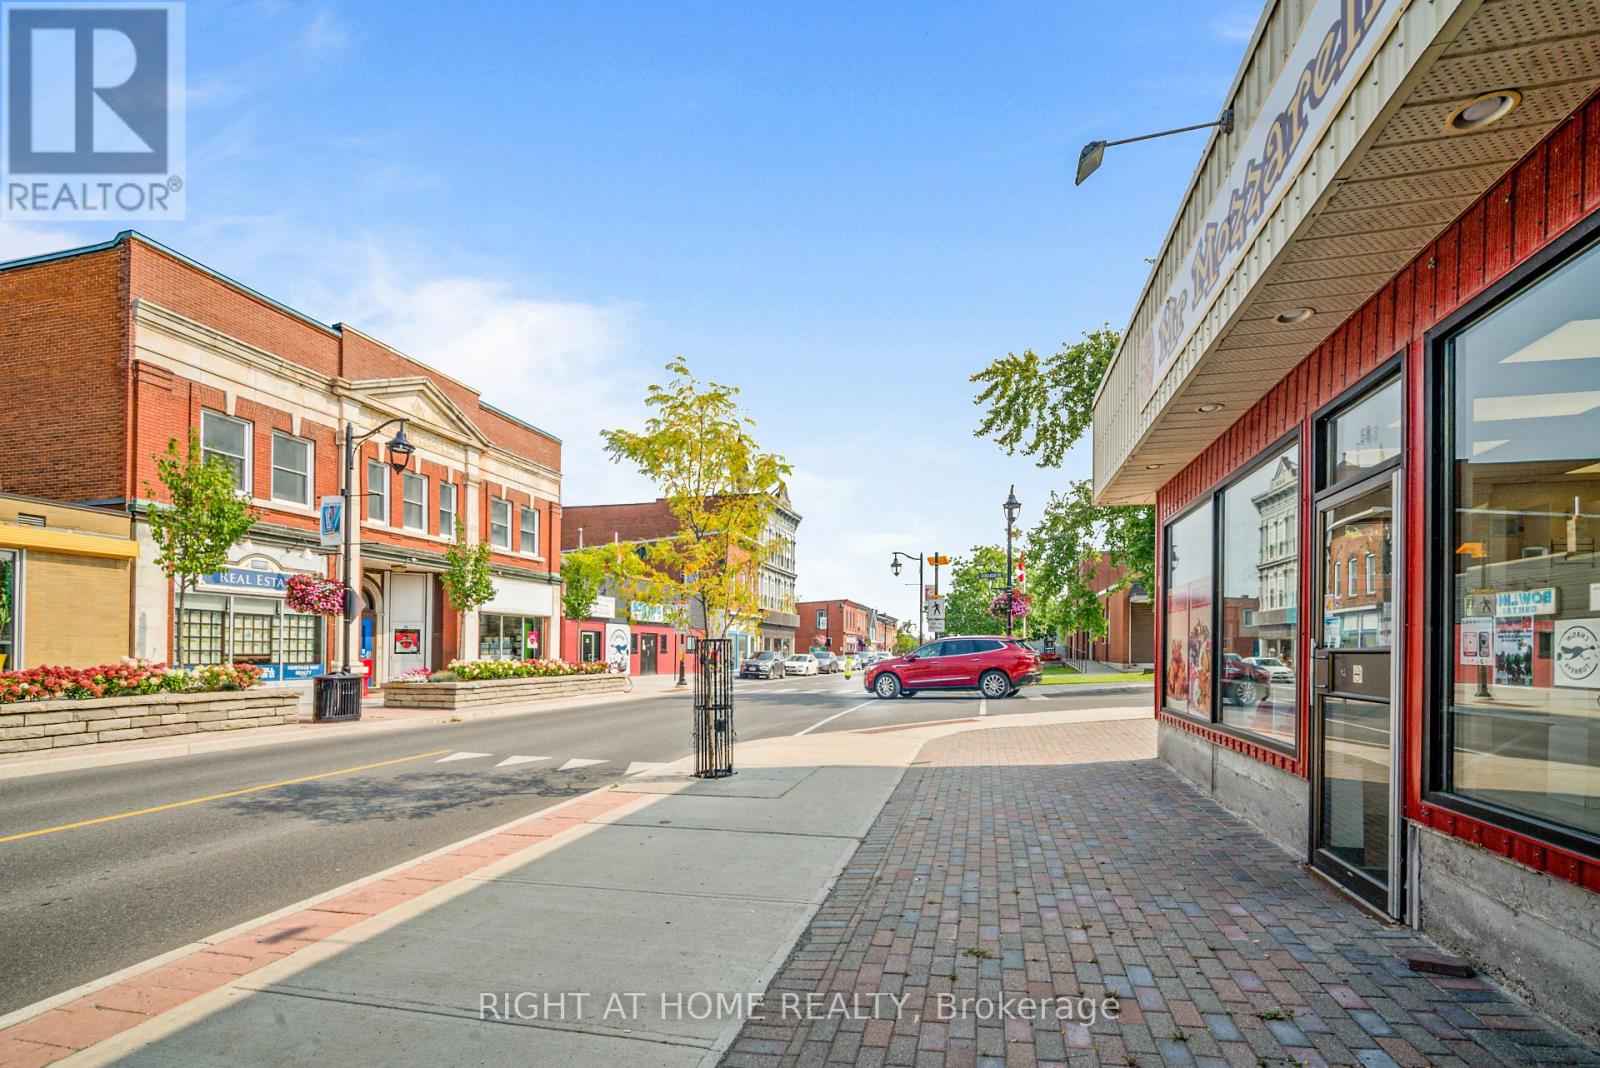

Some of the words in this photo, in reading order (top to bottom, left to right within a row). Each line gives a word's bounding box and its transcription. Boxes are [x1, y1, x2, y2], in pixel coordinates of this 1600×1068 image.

[1159, 288, 1188, 366] Mr
[220, 573, 253, 585] REAL
[256, 574, 288, 589] ESTA
